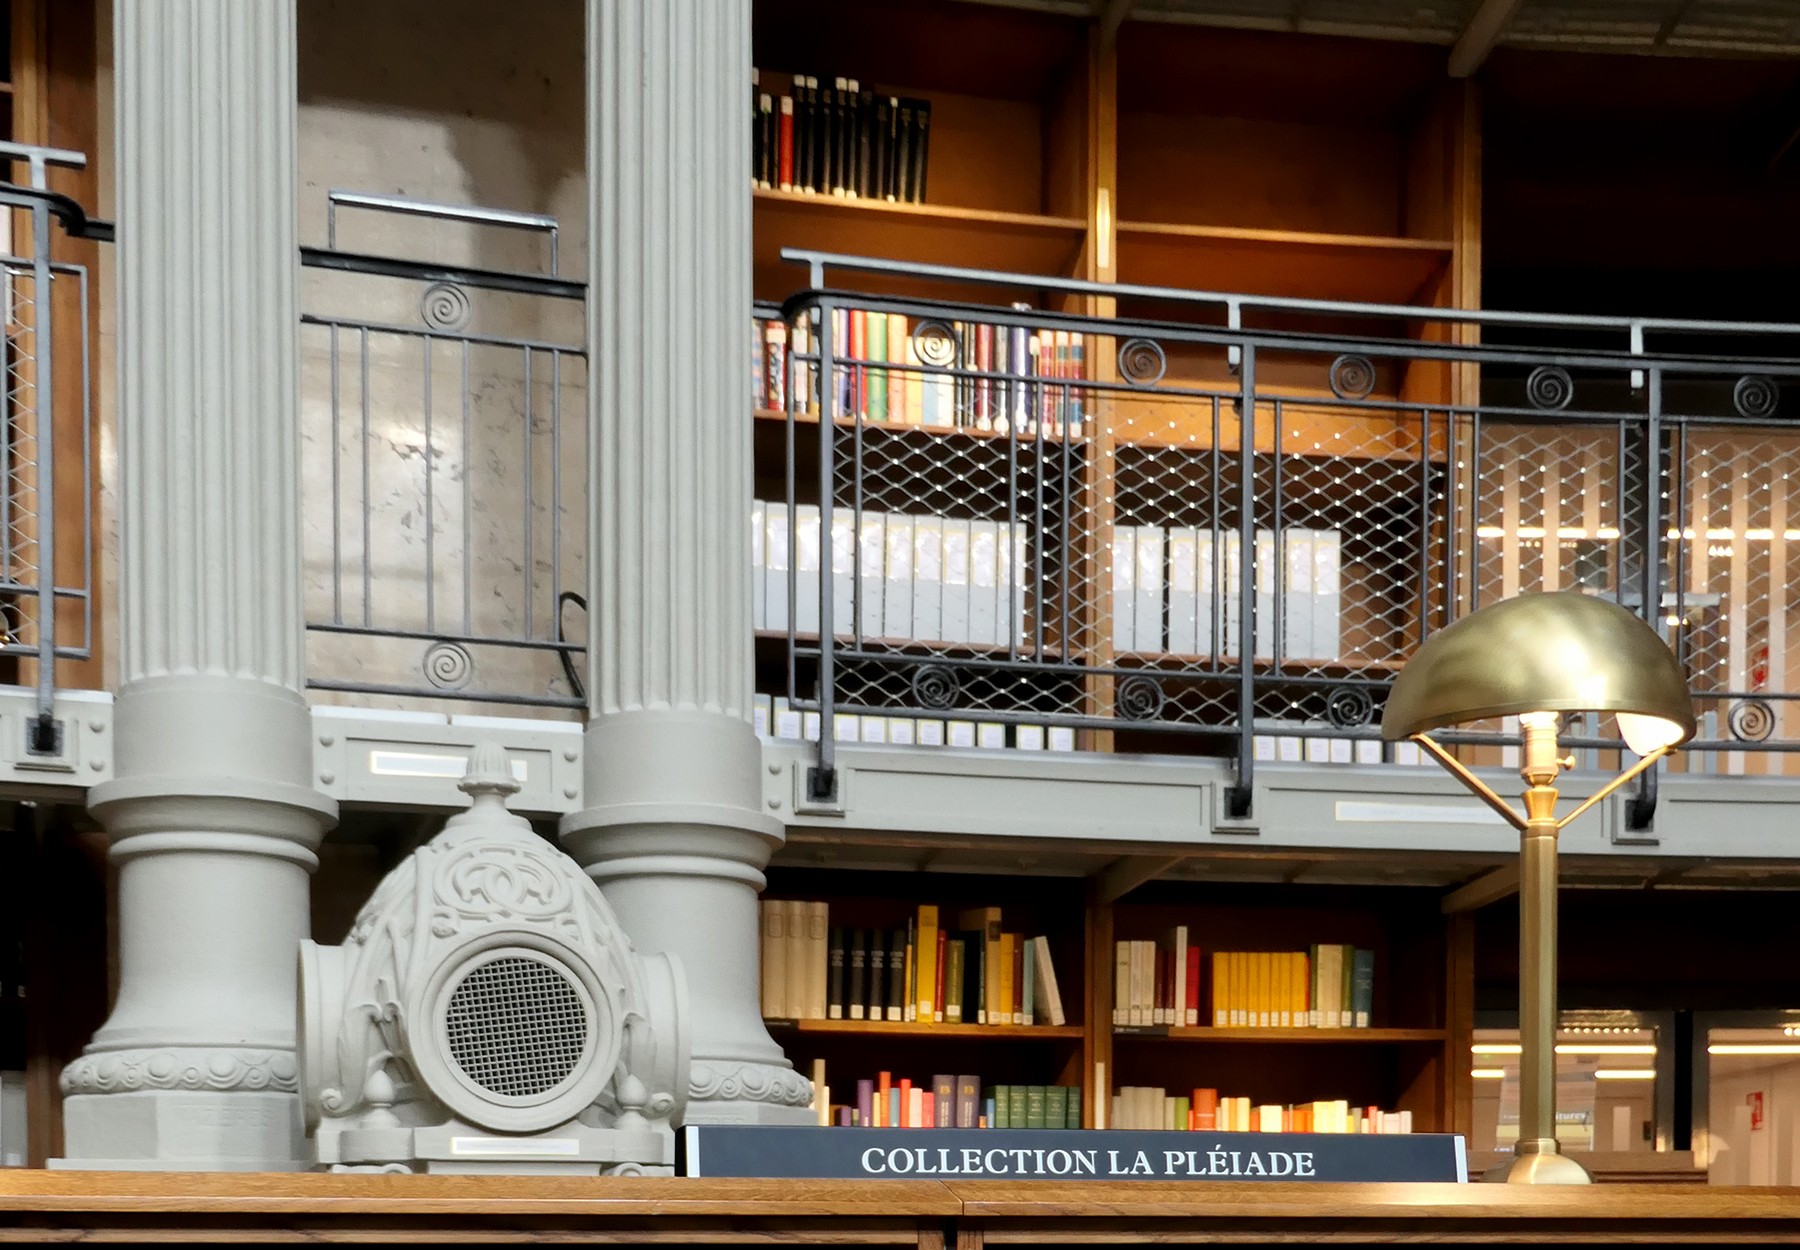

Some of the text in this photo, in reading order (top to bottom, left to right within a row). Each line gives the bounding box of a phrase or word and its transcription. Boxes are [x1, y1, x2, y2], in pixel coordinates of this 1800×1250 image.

[861, 1143, 1316, 1177] COLLECTION LA PLÉIADE
